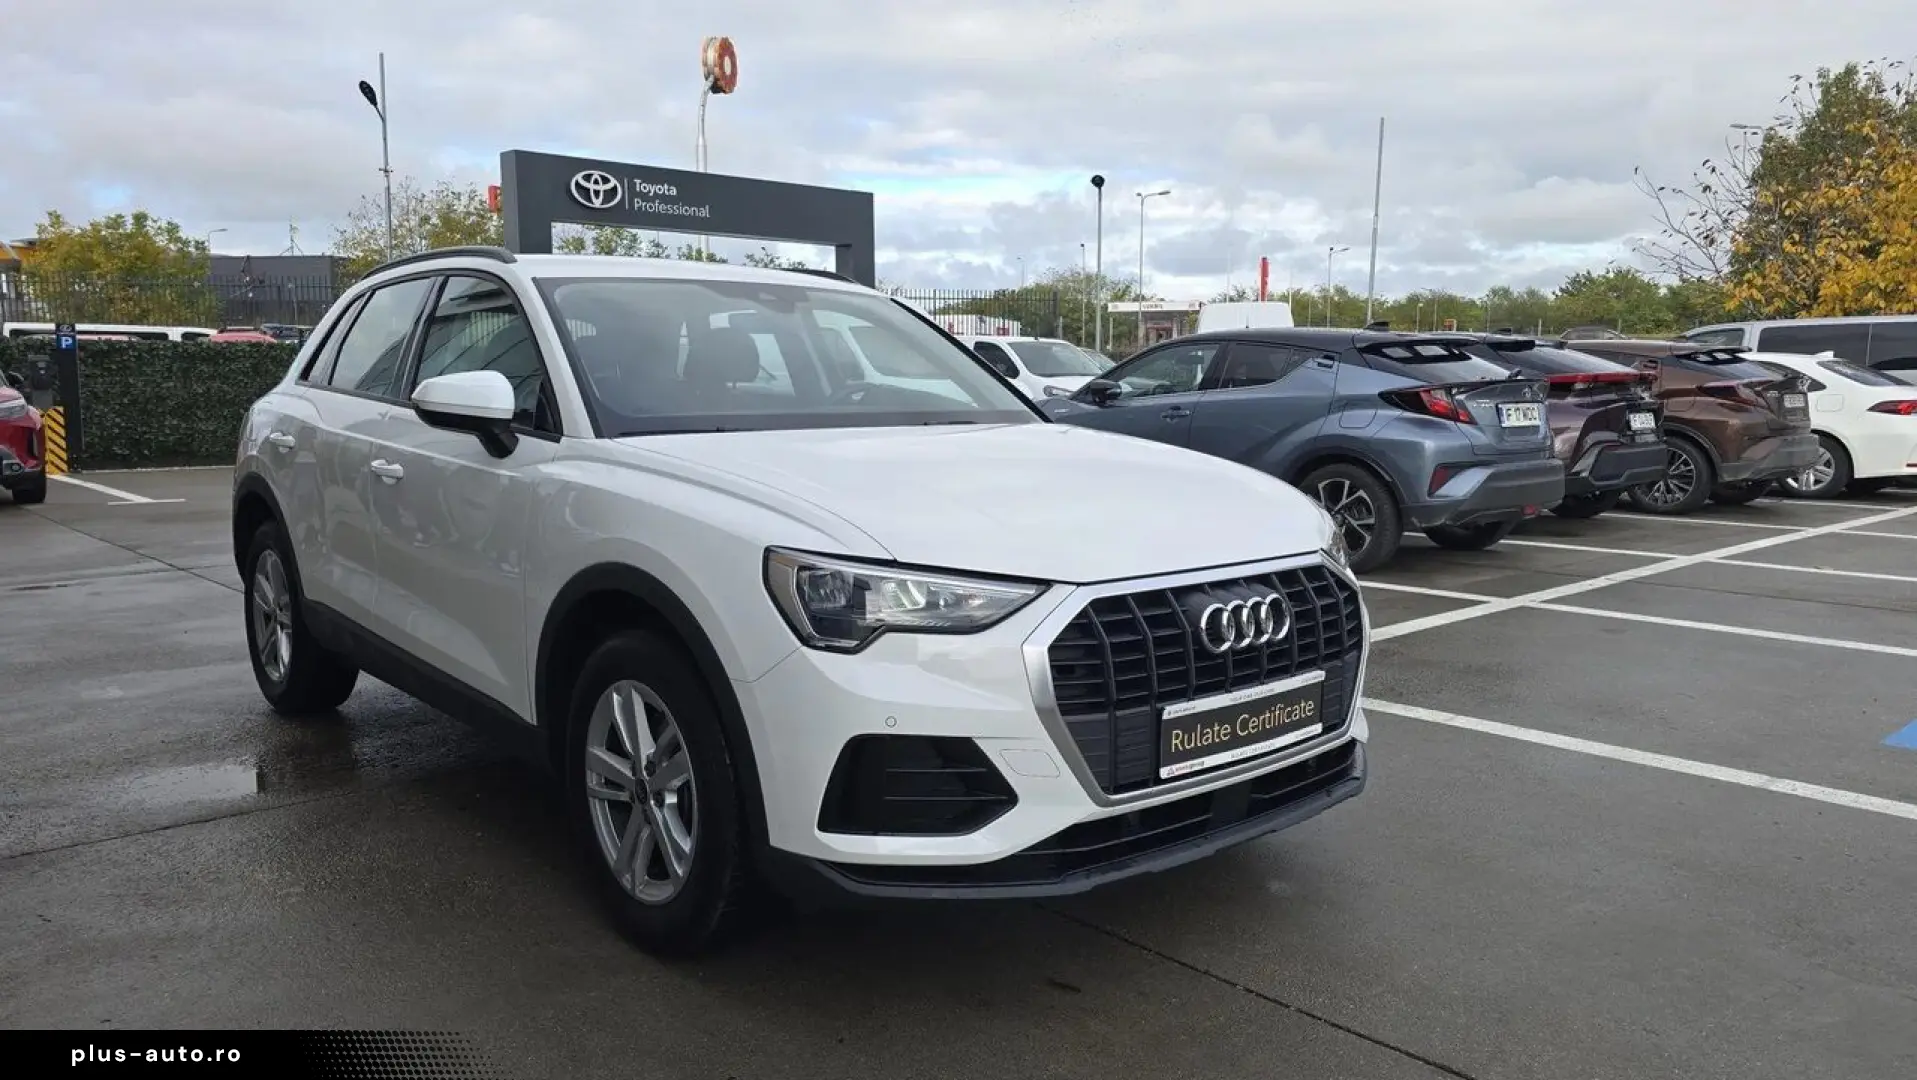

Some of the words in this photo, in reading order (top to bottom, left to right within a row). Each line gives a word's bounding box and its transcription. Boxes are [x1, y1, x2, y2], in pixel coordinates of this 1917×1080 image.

[633, 179, 678, 197] Toyota
[634, 198, 711, 218] Professional
[60, 336, 73, 349] P
[1170, 722, 1232, 753] Rulate
[1236, 699, 1315, 736] Certificate
